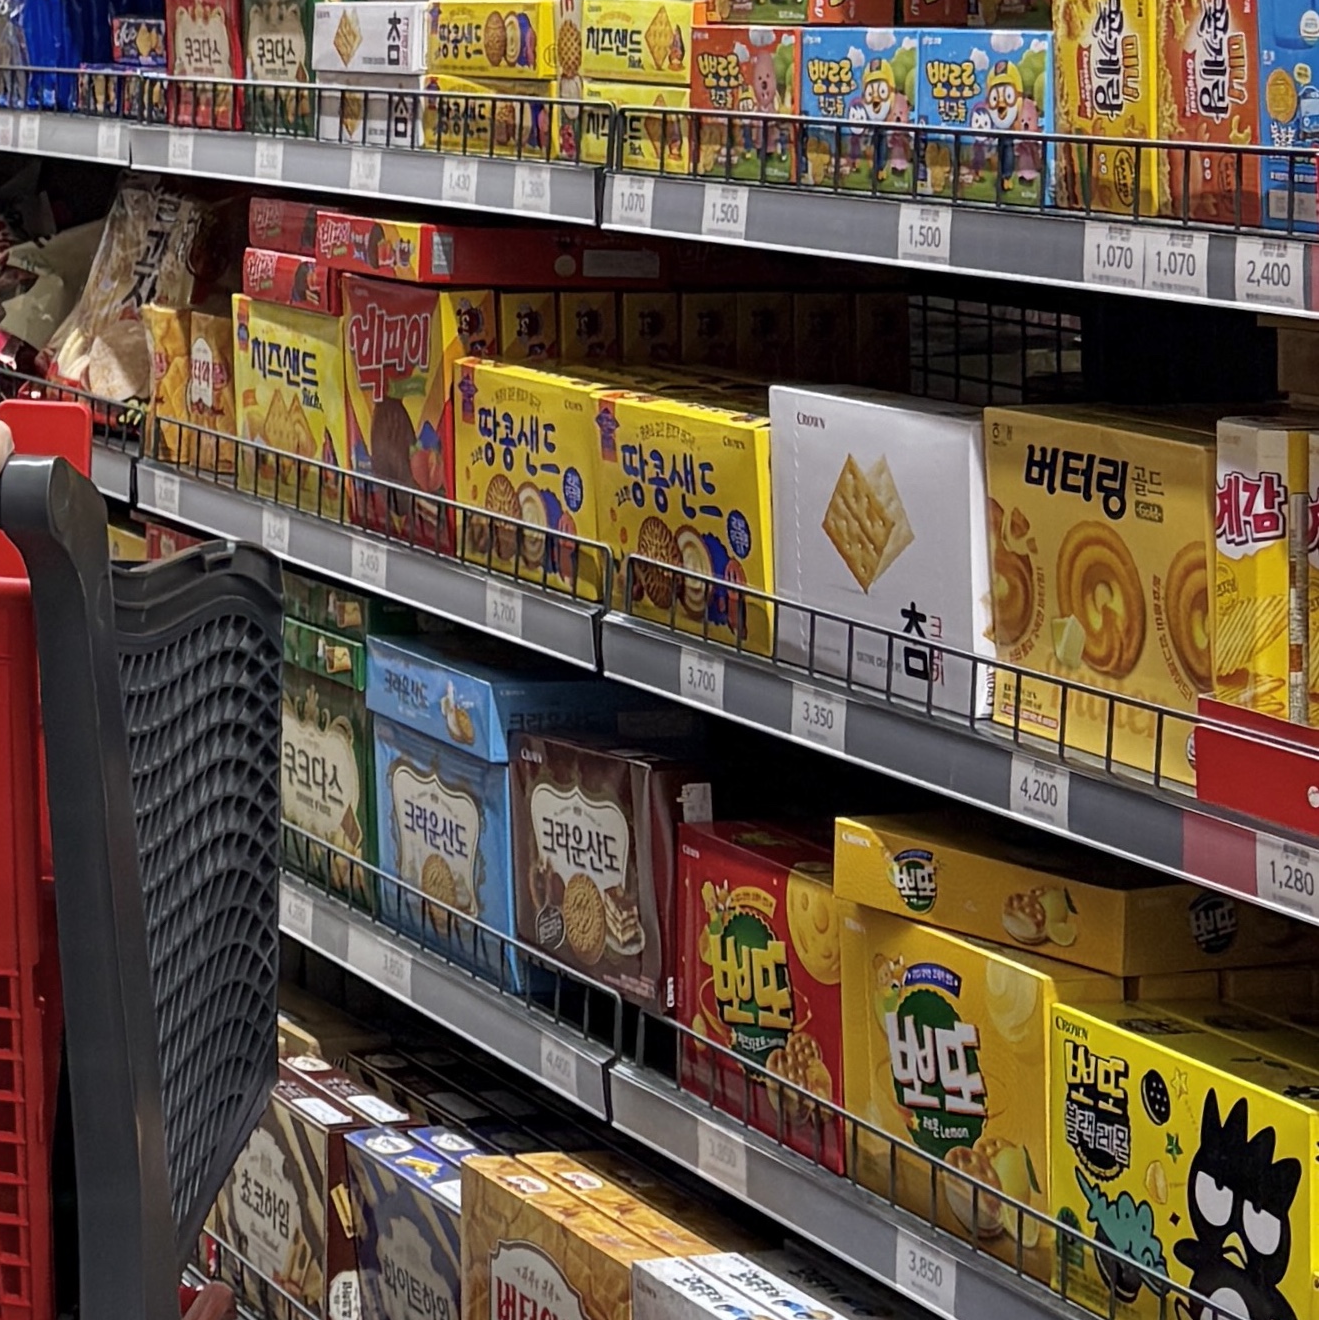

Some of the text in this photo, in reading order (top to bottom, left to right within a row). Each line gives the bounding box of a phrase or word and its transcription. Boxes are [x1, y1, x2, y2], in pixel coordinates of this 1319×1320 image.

[184, 36, 222, 66] 쿠크다스
[257, 36, 297, 68] 쿠크다스
[387, 11, 402, 66] 참
[437, 17, 483, 61] 땅콩샌드
[585, 28, 643, 60] 치즈샌드
[697, 53, 744, 87] 뽀로로
[807, 57, 858, 95] 뽀로로
[925, 59, 981, 98] 뽀로로
[1121, 34, 1140, 102] 미니
[1227, 32, 1247, 104] 미니
[708, 86, 733, 109] 친구들
[819, 94, 846, 118] 친구들
[936, 98, 968, 123] 친구들
[619, 192, 646, 213] 1,070
[711, 201, 740, 226] 1,500
[319, 218, 350, 254] 빅파이
[907, 223, 943, 251] 1,500
[246, 255, 276, 286] 빅파이
[1095, 242, 1133, 271] 1,070
[1154, 247, 1197, 278] 1,070
[1246, 260, 1291, 289] 2,400
[250, 337, 319, 387] 치즈샌드
[348, 302, 431, 404] 빅파이
[302, 388, 323, 411] Rich
[796, 411, 826, 430] CROWN
[479, 407, 561, 477] 땅콩샌드
[621, 442, 724, 521] 땅콩샌드
[1024, 443, 1164, 520] 버터링 골드
[1138, 503, 1160, 520] Gold
[491, 601, 517, 624] 3,700
[899, 600, 932, 681] 참
[687, 665, 717, 694] 3,700
[802, 701, 835, 730] 3,350
[283, 738, 345, 807] 쿠크다스
[1019, 775, 1059, 808] 4,200
[403, 798, 470, 862] 크라운산도
[542, 816, 623, 876] 크라운산도
[894, 865, 938, 898] 뽀또
[1269, 858, 1315, 900] 1,280
[710, 933, 796, 1034] 뽀또
[1055, 1014, 1090, 1041] CROWN
[884, 1011, 987, 1118] 뽀또
[1064, 1040, 1130, 1116] 뽀또
[922, 1114, 970, 1141] 레몬 Lemon
[237, 1163, 292, 1239] 초코하임
[907, 1251, 944, 1288] 3,850
